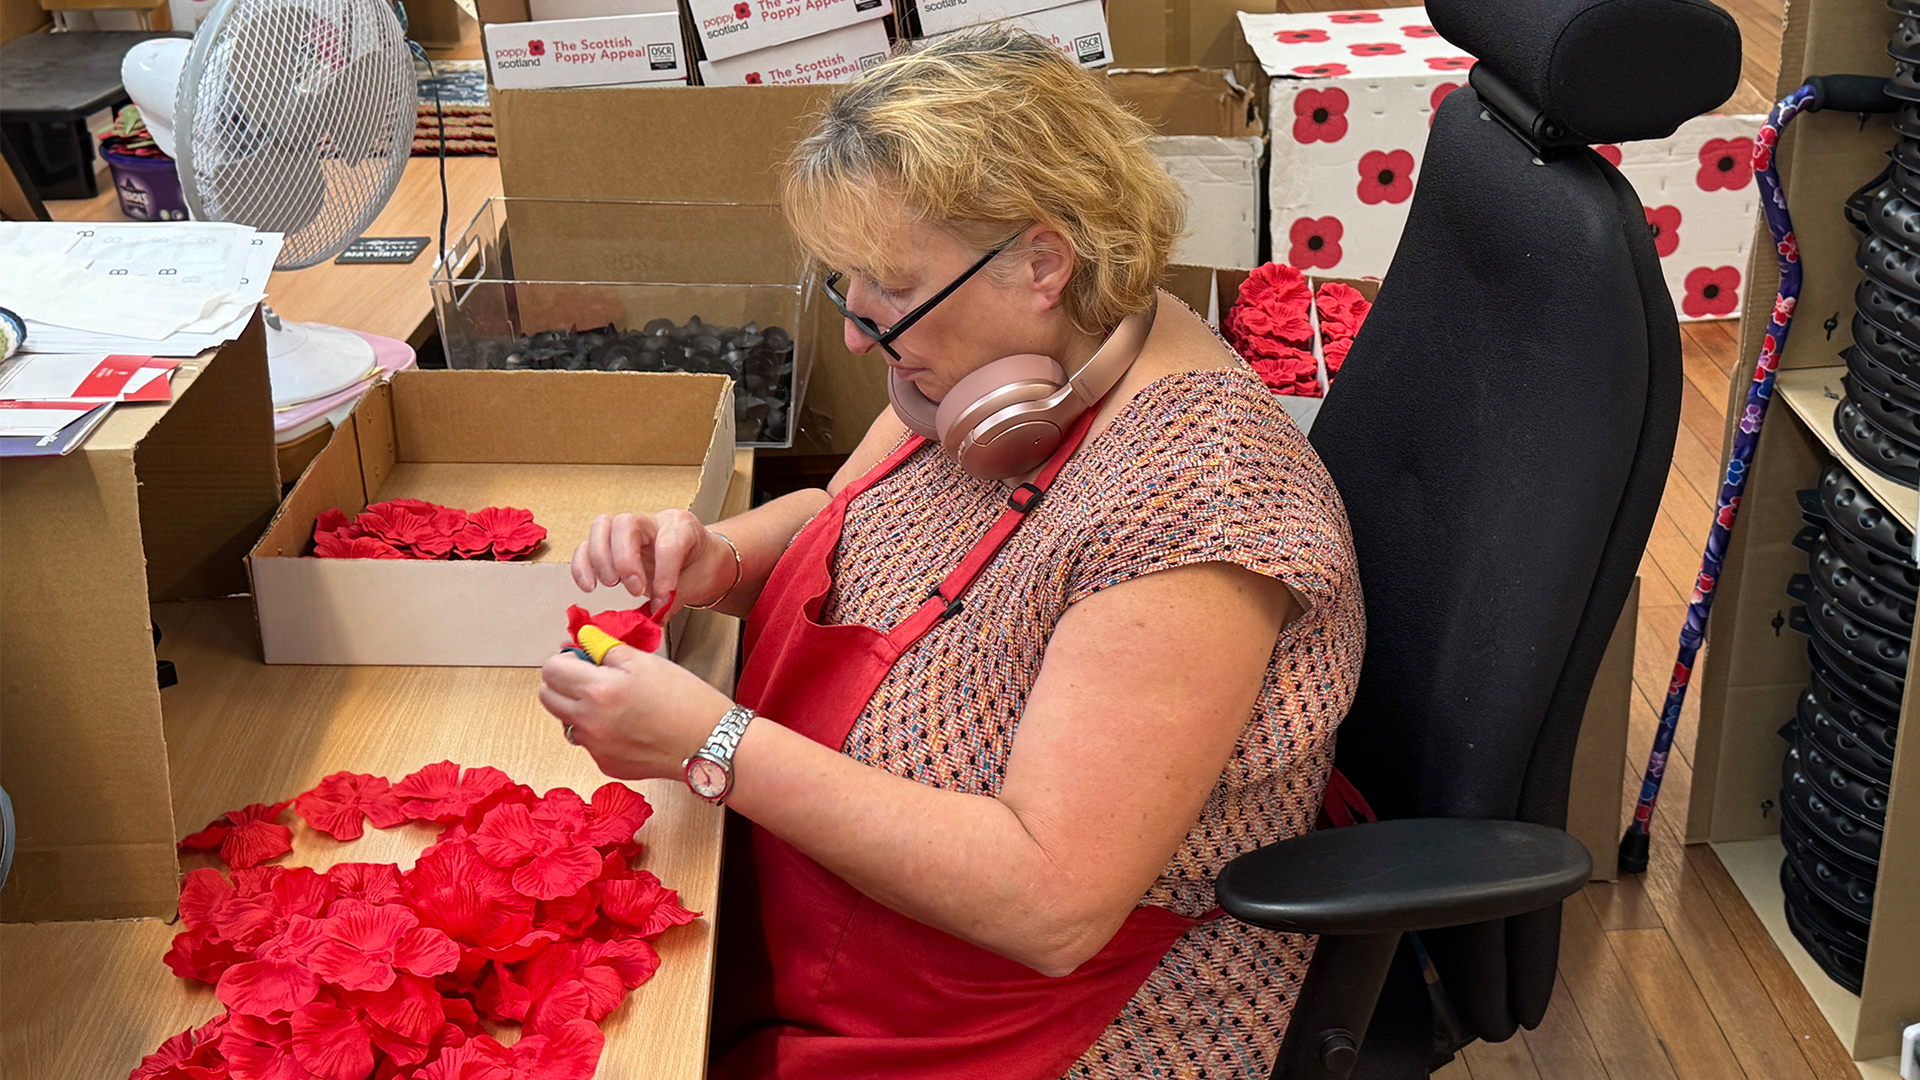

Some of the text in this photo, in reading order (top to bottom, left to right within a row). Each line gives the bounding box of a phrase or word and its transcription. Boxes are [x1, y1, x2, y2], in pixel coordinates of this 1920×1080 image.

[703, 13, 735, 29] poppy
[761, 5, 801, 21] Poppy
[707, 21, 749, 39] scotland
[553, 36, 633, 53] The Scottish
[1079, 37, 1099, 48] OSCR
[495, 47, 528, 59] poppy
[555, 46, 646, 65] Poppy Appeal
[651, 47, 672, 56] OSCR
[498, 57, 541, 69] scotland
[768, 53, 845, 81] The Scottish
[816, 60, 860, 81] Appeal
